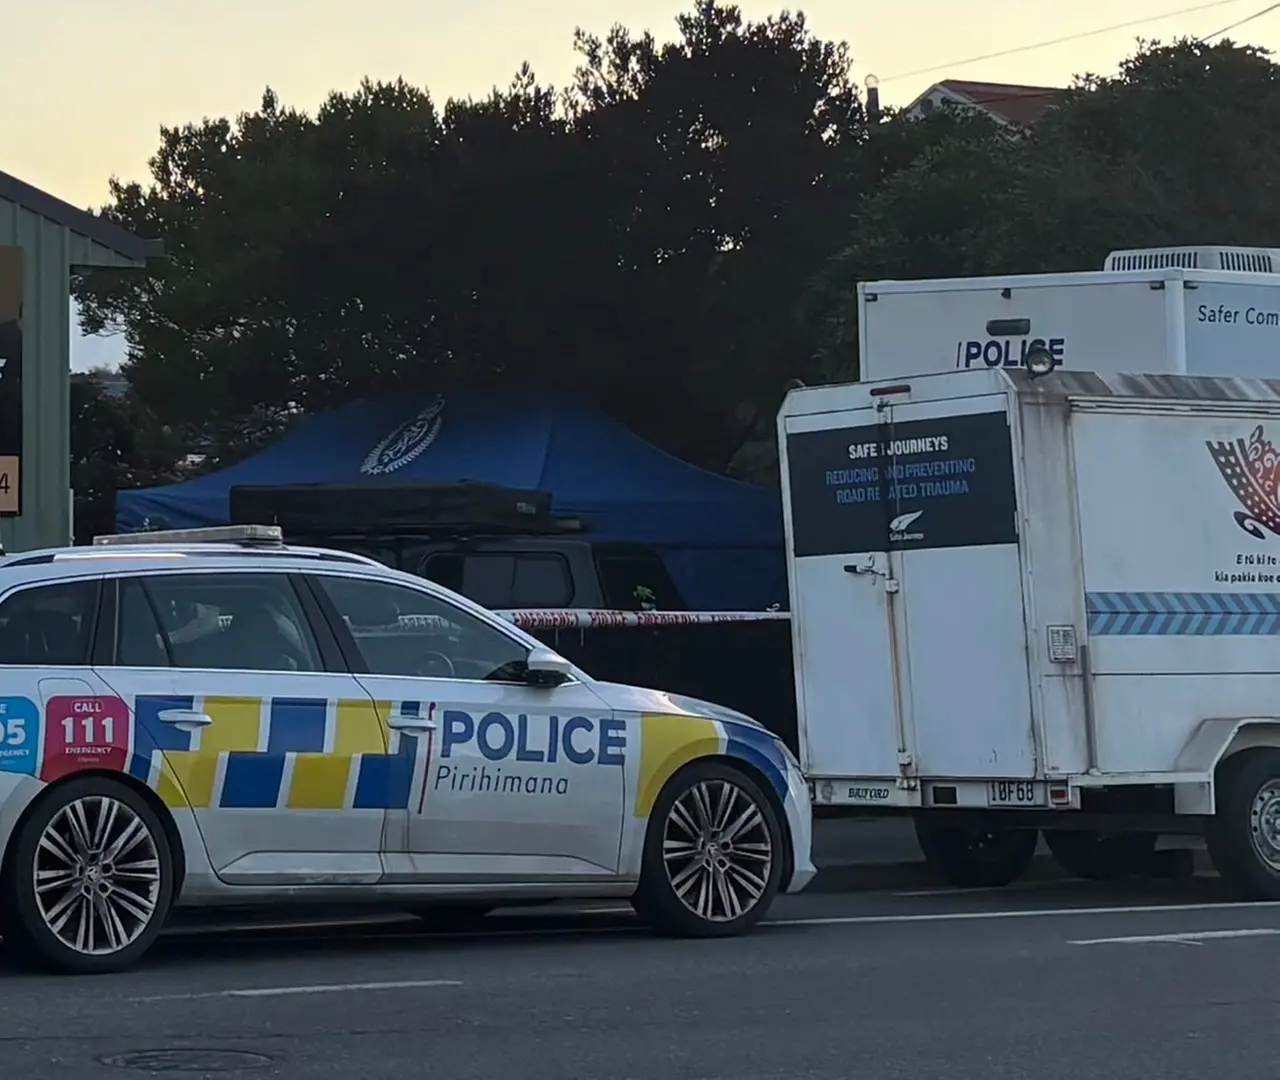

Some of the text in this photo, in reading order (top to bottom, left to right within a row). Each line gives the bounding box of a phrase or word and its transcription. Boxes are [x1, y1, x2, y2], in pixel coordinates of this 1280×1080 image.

[1198, 304, 1279, 326] Safer Com
[887, 436, 949, 456] JOURNEYS
[826, 467, 879, 485] REDUCING
[905, 458, 976, 478] PREVENTING
[837, 480, 969, 504] ROAD REATED TRAUMA
[74, 702, 102, 713] CALL
[61, 717, 114, 744] 111
[440, 710, 627, 765] POLICE
[434, 765, 569, 795] Pirihimana
